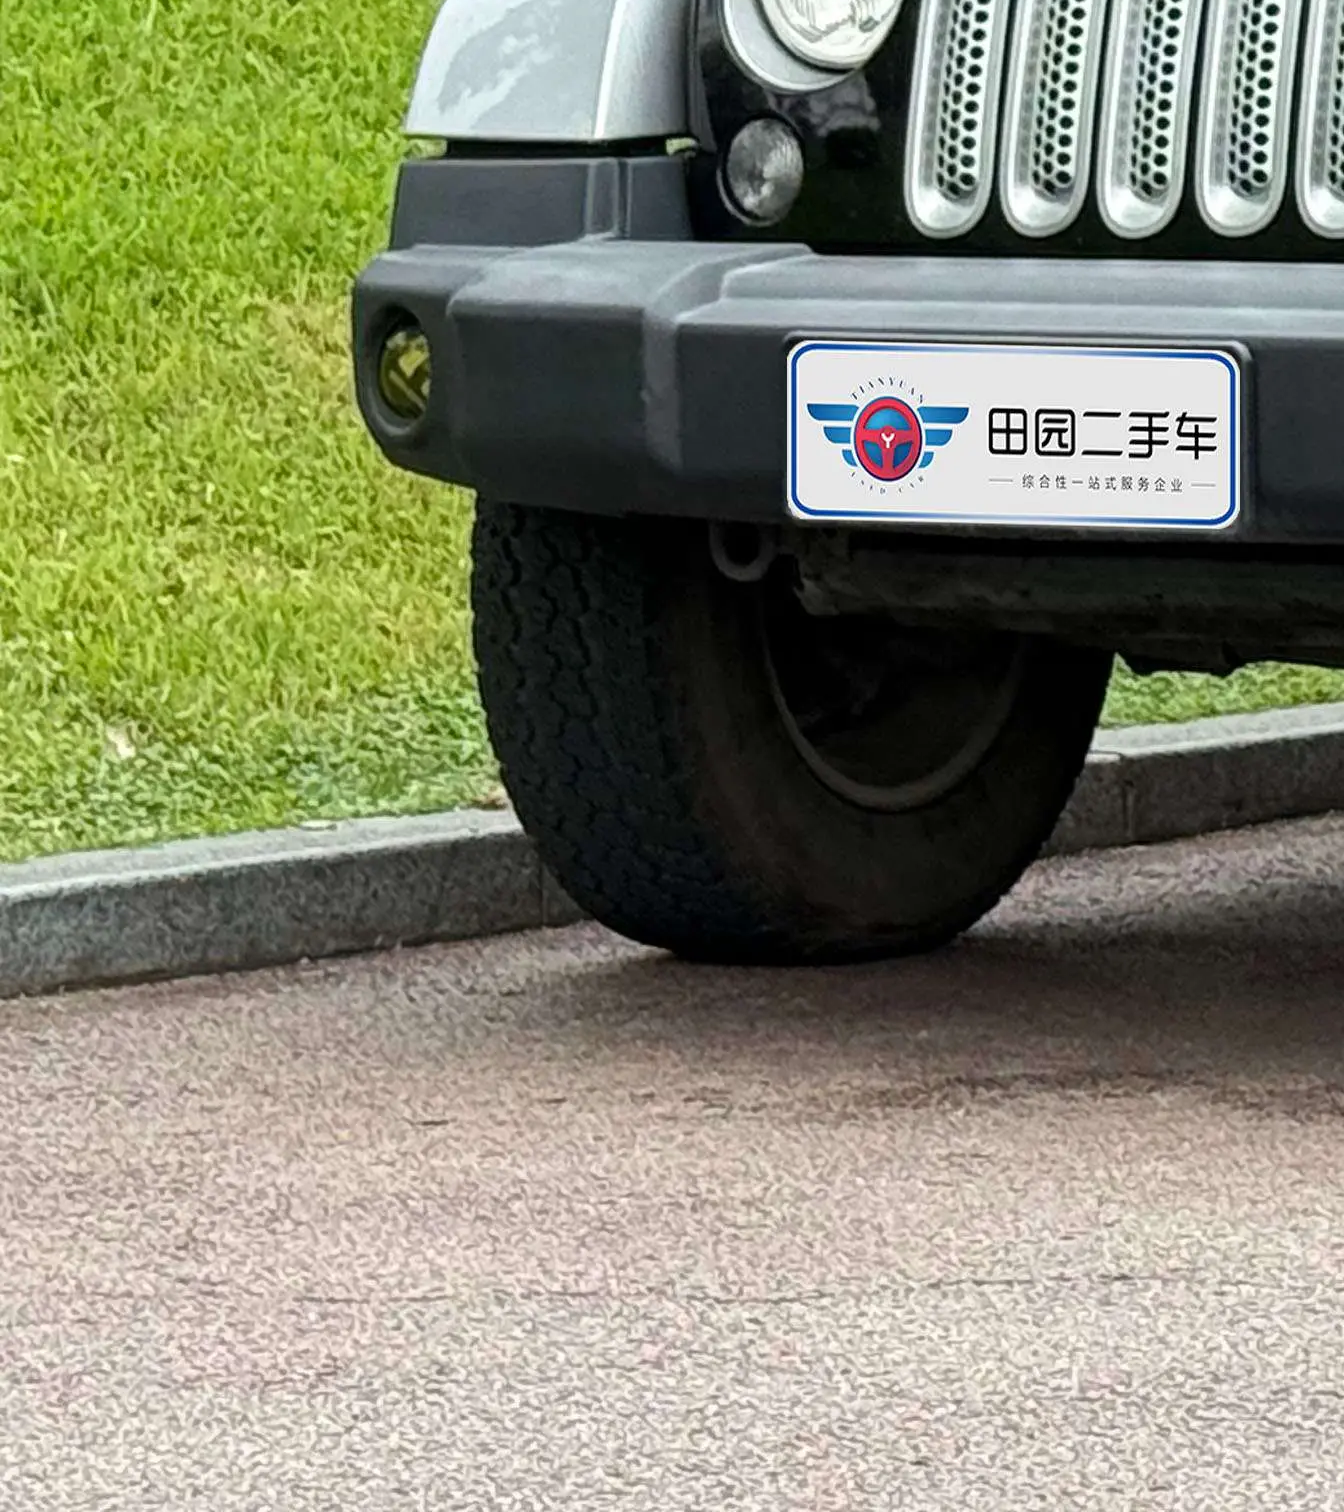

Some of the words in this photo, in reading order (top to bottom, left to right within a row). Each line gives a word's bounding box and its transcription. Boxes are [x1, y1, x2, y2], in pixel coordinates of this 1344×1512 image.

[988, 406, 1218, 460] 田园二手车
[1021, 473, 1184, 493] 综合性一站式服务企业
